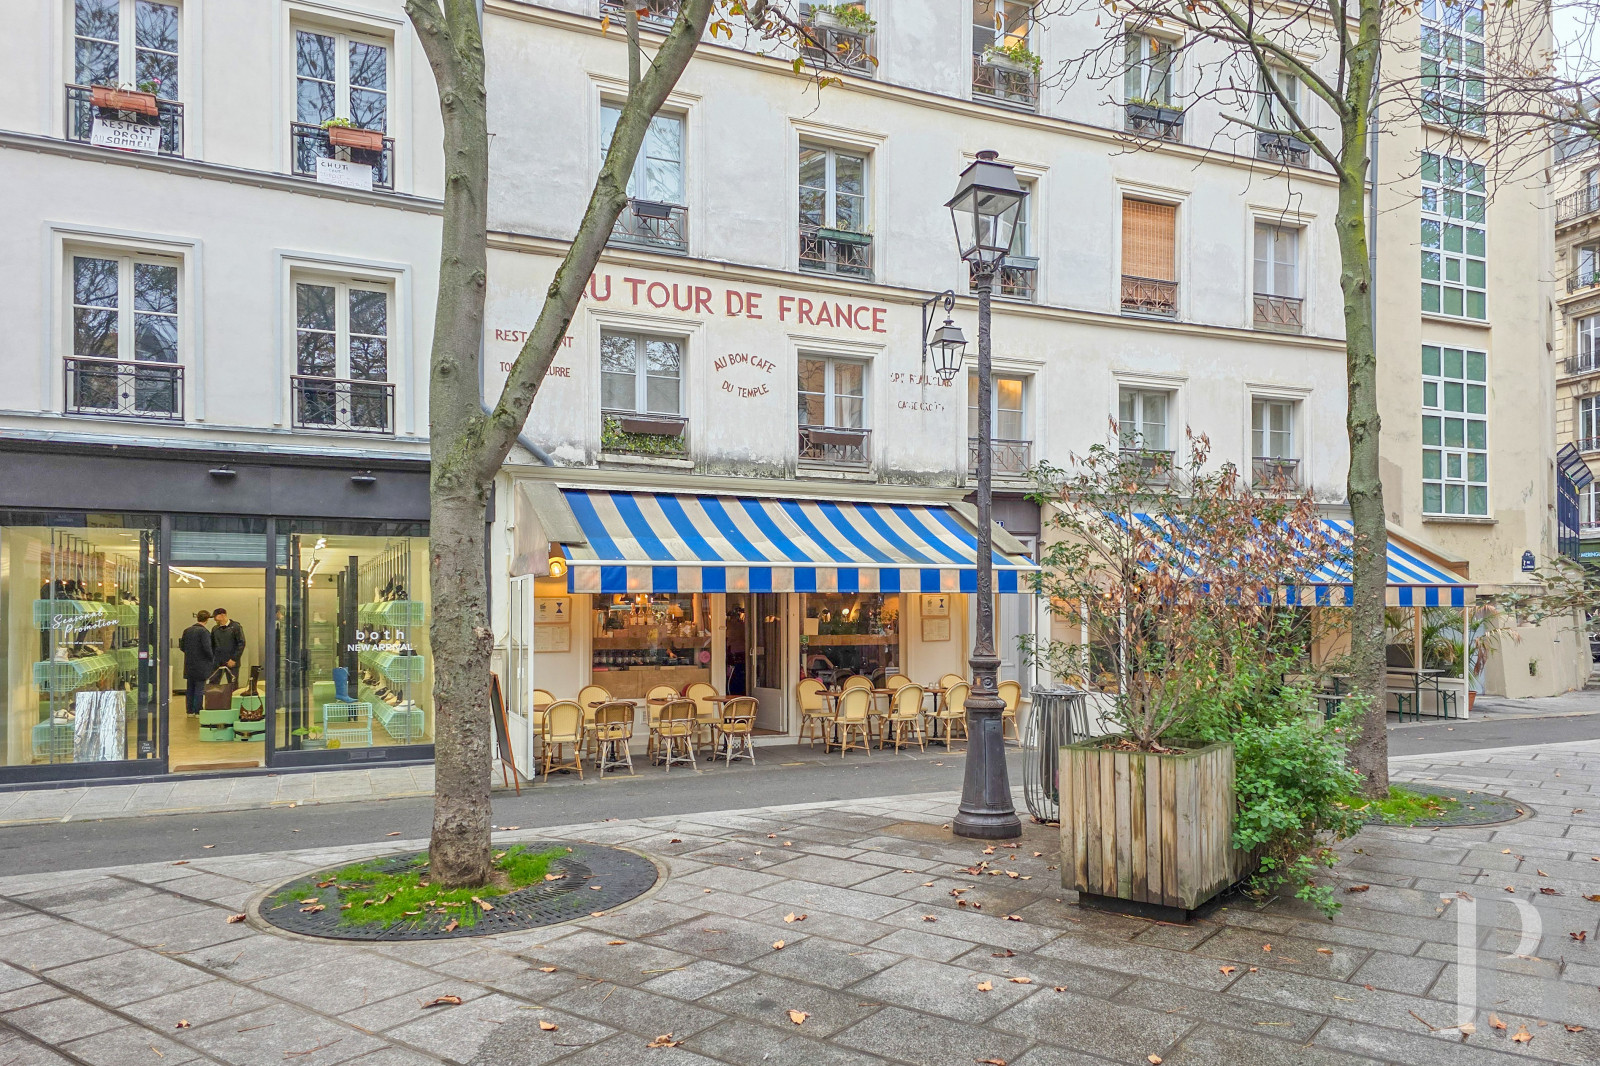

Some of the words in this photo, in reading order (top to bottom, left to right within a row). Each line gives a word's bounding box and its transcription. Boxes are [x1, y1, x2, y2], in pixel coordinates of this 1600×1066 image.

[102, 119, 156, 136] RESPECT
[583, 272, 611, 302] U
[623, 277, 715, 316] TOUR
[725, 289, 763, 320] DE
[778, 295, 888, 334] FRANCE
[713, 356, 728, 372] AU
[728, 352, 749, 366] BON
[750, 355, 777, 374] CAFE
[721, 380, 734, 393] DU
[737, 383, 770, 398] TEMPLE
[52, 607, 104, 630] Seasonal
[64, 618, 120, 639] Promotion
[355, 629, 405, 640] both
[347, 643, 370, 652] NEW
[371, 643, 413, 652] ARRIVAL
